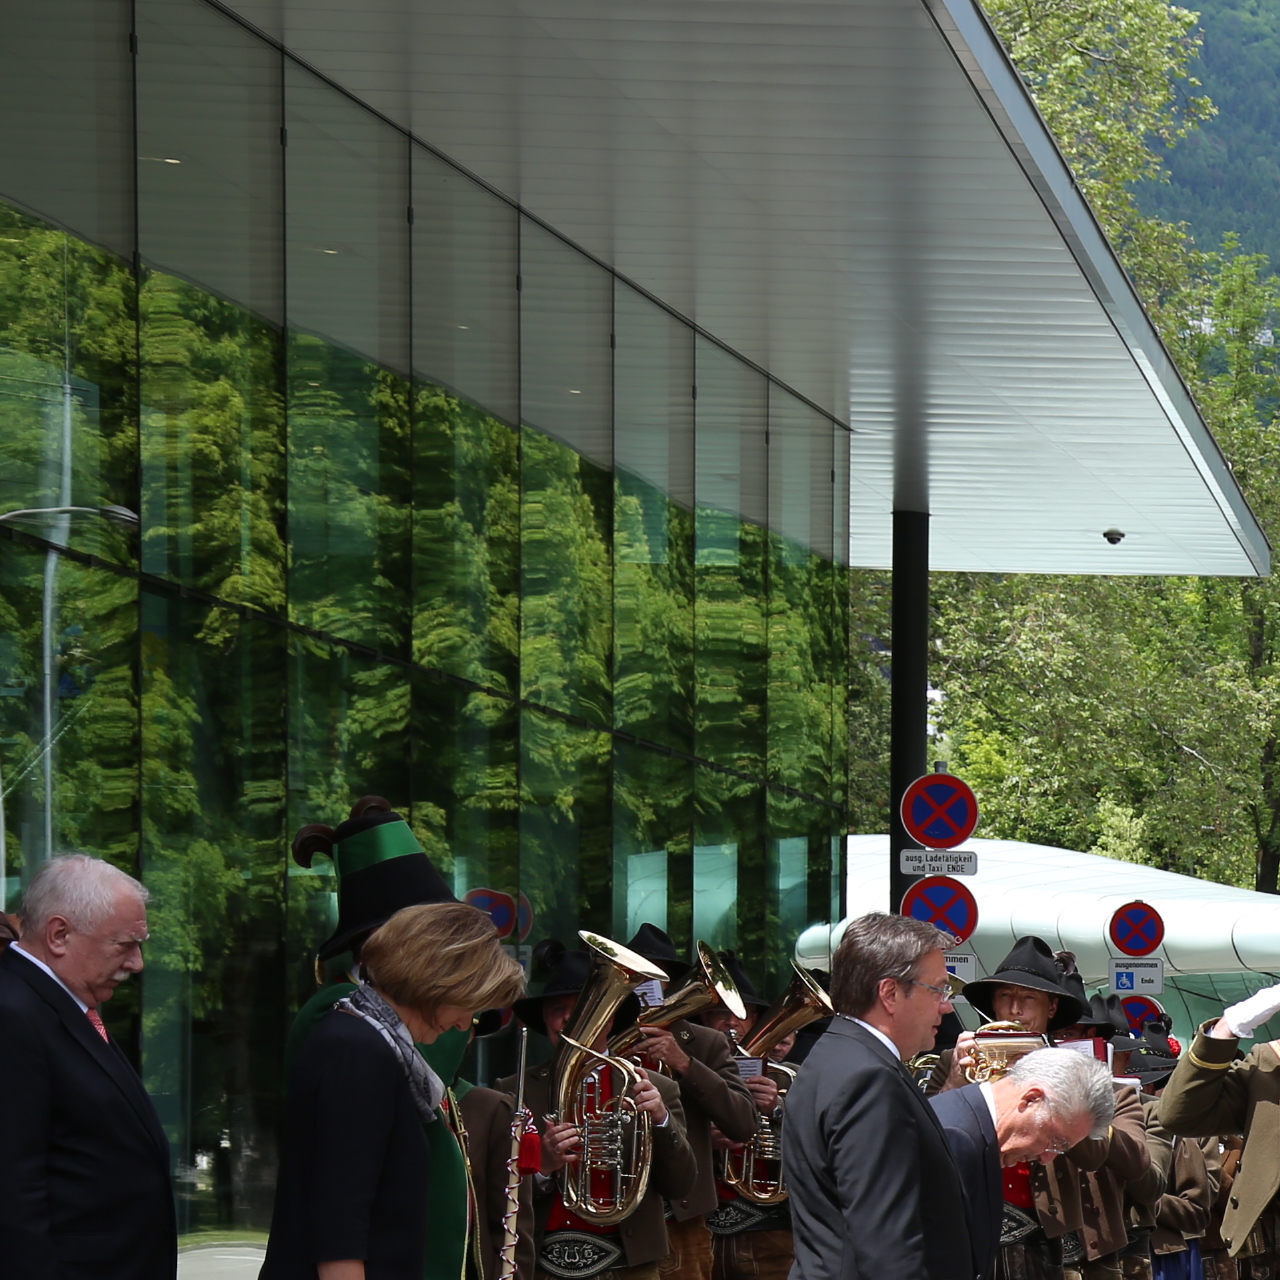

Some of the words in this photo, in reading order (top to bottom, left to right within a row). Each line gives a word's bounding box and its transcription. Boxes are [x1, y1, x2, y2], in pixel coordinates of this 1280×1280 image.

[905, 854, 924, 864] ausg.
[912, 864, 926, 872] und
[928, 864, 943, 872] Taxi
[947, 864, 965, 872] ENDE
